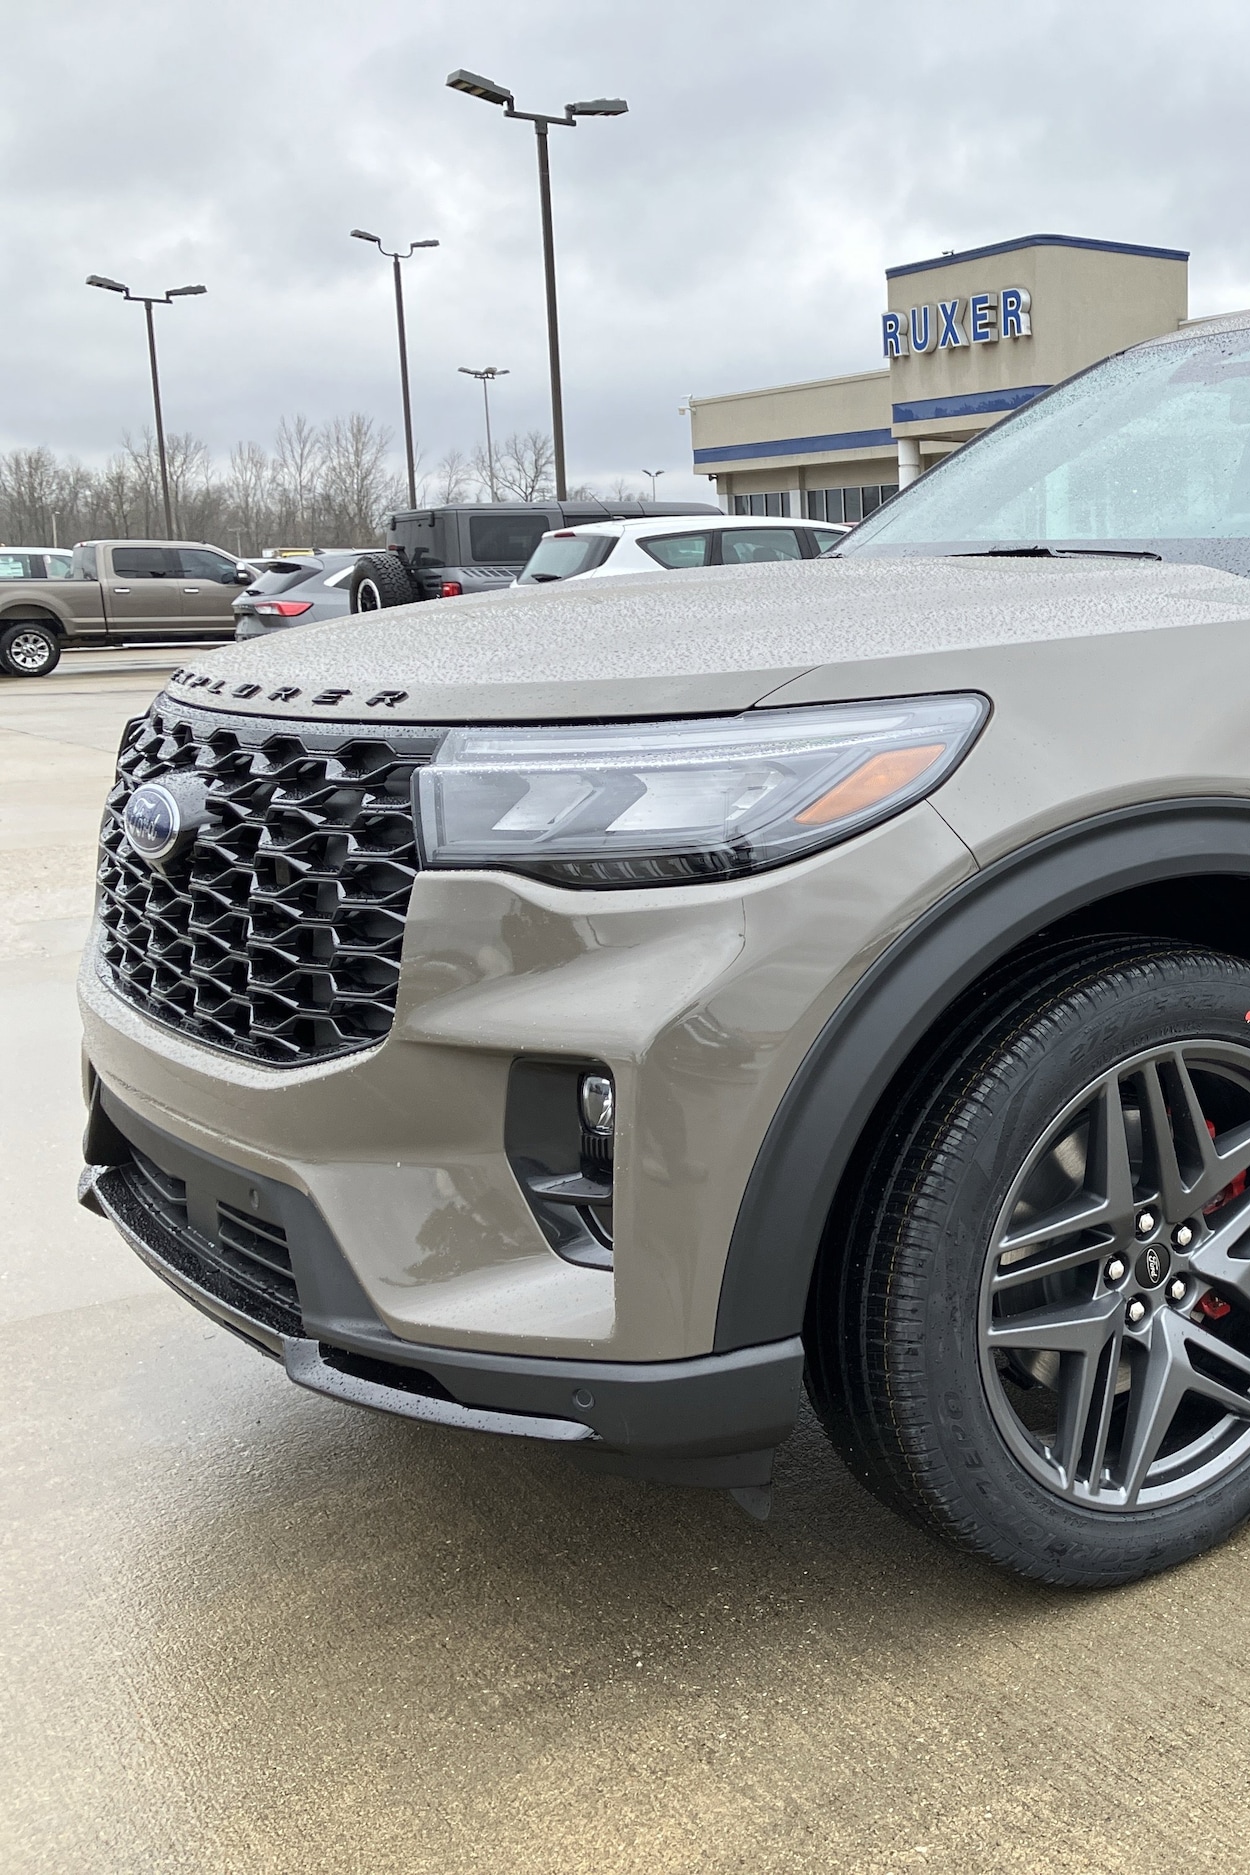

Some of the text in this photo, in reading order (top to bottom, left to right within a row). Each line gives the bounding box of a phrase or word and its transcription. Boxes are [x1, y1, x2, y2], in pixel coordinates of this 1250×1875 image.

[882, 287, 1032, 358] RUXER
[170, 668, 410, 708] EXPLORER
[127, 797, 161, 842] Ford
